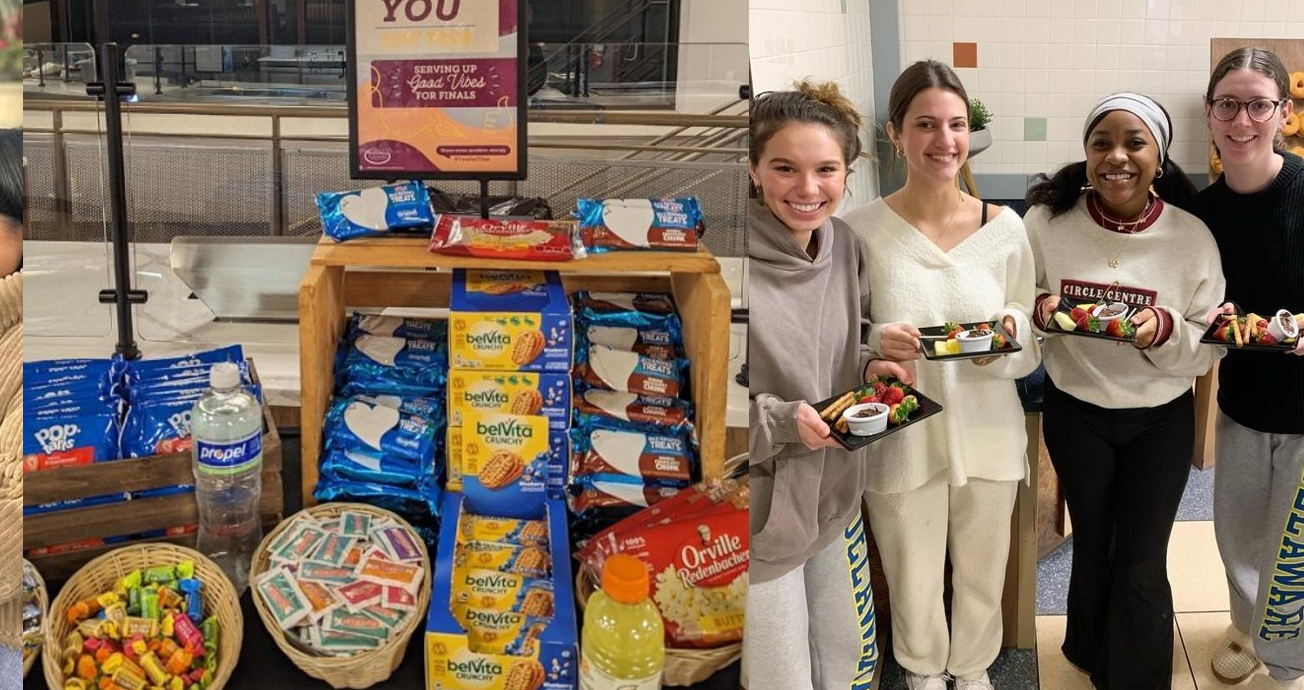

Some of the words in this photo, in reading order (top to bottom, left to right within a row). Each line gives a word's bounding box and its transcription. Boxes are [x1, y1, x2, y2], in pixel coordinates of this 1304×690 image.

[381, 0, 461, 22] YOU
[414, 65, 460, 75] SERVING
[462, 64, 478, 74] UP
[407, 74, 444, 93] Good
[446, 73, 486, 91] Vibes
[415, 91, 437, 101] FOR
[438, 91, 476, 100] FINALS
[1063, 284, 1103, 299] CIRCLE
[1106, 290, 1153, 306] CENTRE
[465, 330, 511, 345] belVita
[641, 361, 672, 375] TREATS
[464, 389, 509, 403] belVita
[476, 418, 533, 438] belVita
[485, 437, 524, 446] CRUNCHY
[650, 441, 682, 451] TREATS
[200, 444, 246, 465] propel
[681, 533, 742, 570] Orville
[678, 549, 749, 590] Redenbacher
[465, 574, 517, 588] belVita
[472, 586, 508, 594] CRUNCHY
[465, 608, 521, 624] belVita
[473, 621, 511, 630] CRUNCHY
[447, 657, 503, 675] belVita
[455, 672, 494, 681] CRUNCHY
